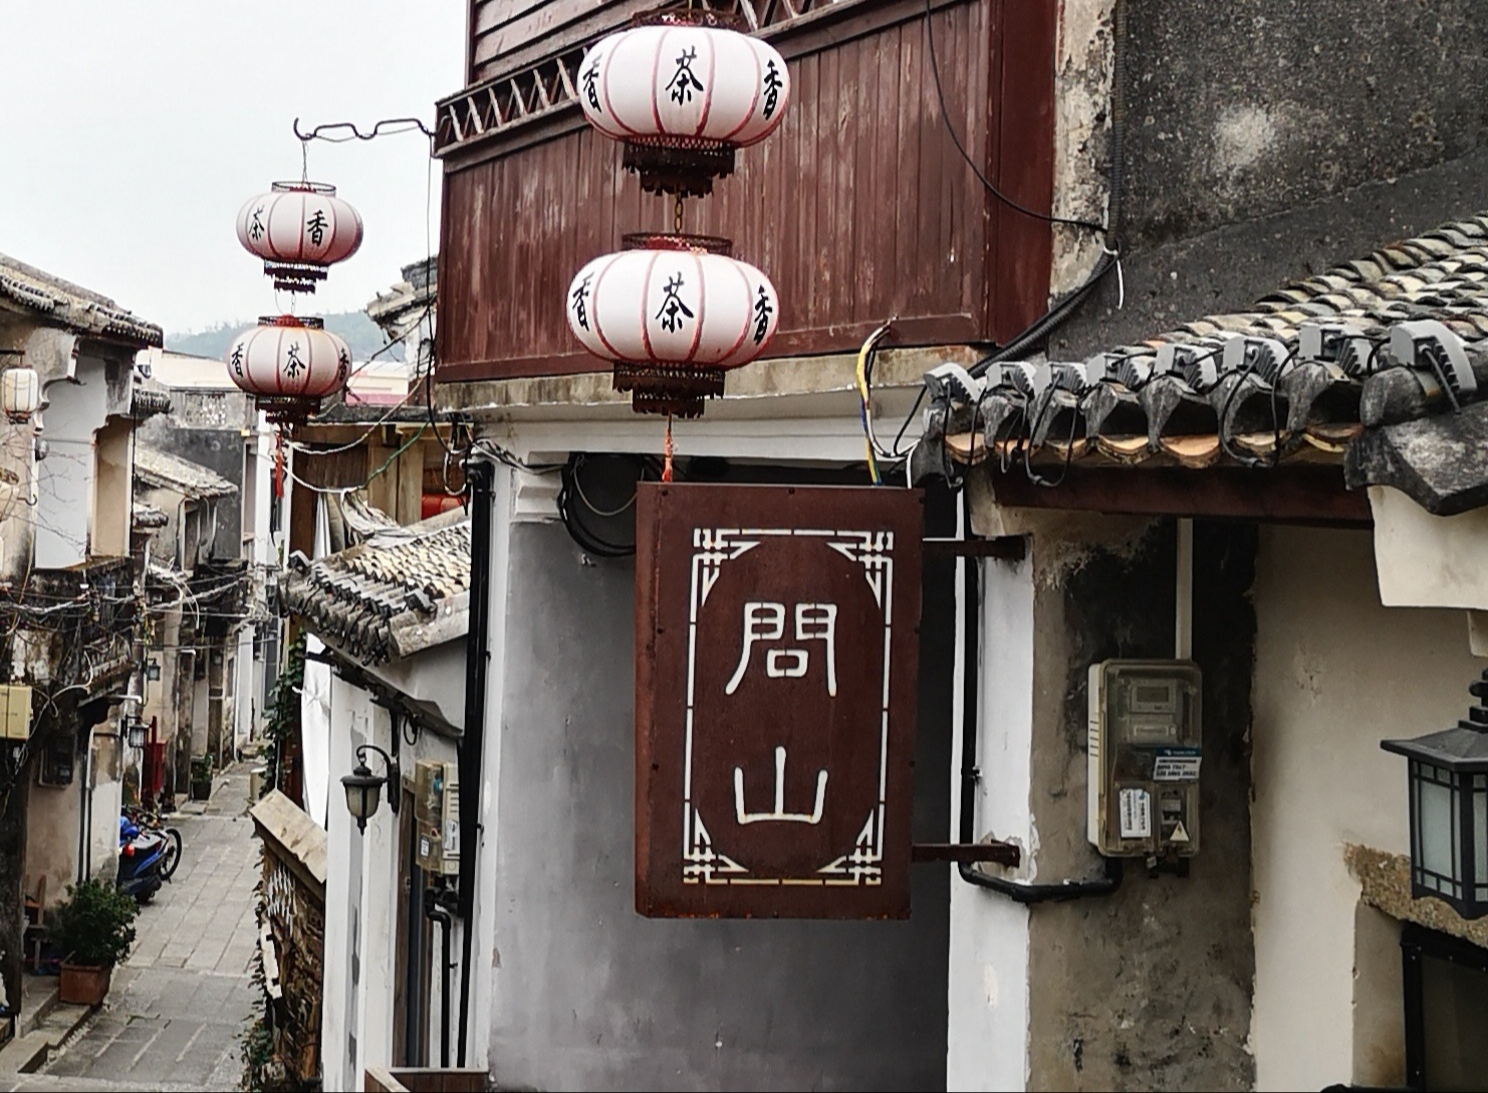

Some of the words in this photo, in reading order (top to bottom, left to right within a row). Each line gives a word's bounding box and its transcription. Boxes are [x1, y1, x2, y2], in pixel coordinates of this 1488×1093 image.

[665, 45, 704, 106] 茶
[762, 59, 783, 121] 香
[248, 205, 265, 241] 茶
[307, 209, 329, 247] 香
[655, 271, 694, 334] 茶
[753, 285, 773, 345] 香
[283, 341, 306, 379] 茶
[725, 601, 839, 825] 問山
